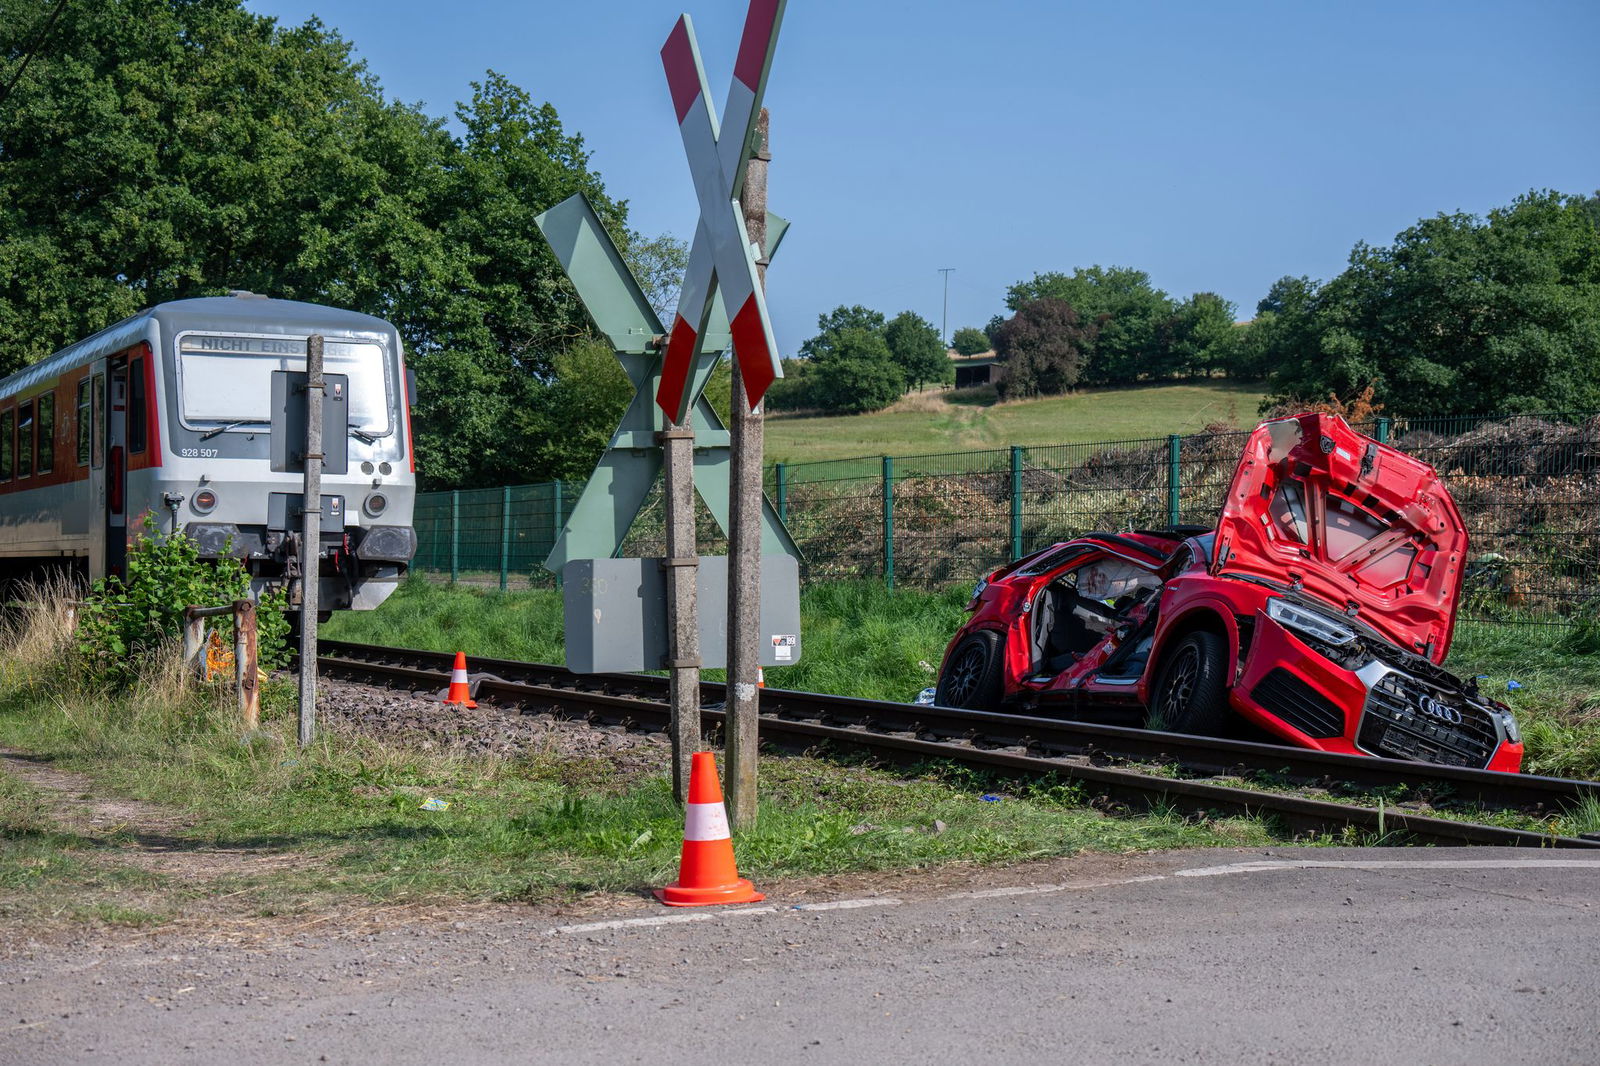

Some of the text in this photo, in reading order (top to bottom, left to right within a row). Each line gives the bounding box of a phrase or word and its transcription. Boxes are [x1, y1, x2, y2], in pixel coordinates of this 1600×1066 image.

[201, 338, 251, 351] NICHT
[181, 448, 218, 458] 928 507
